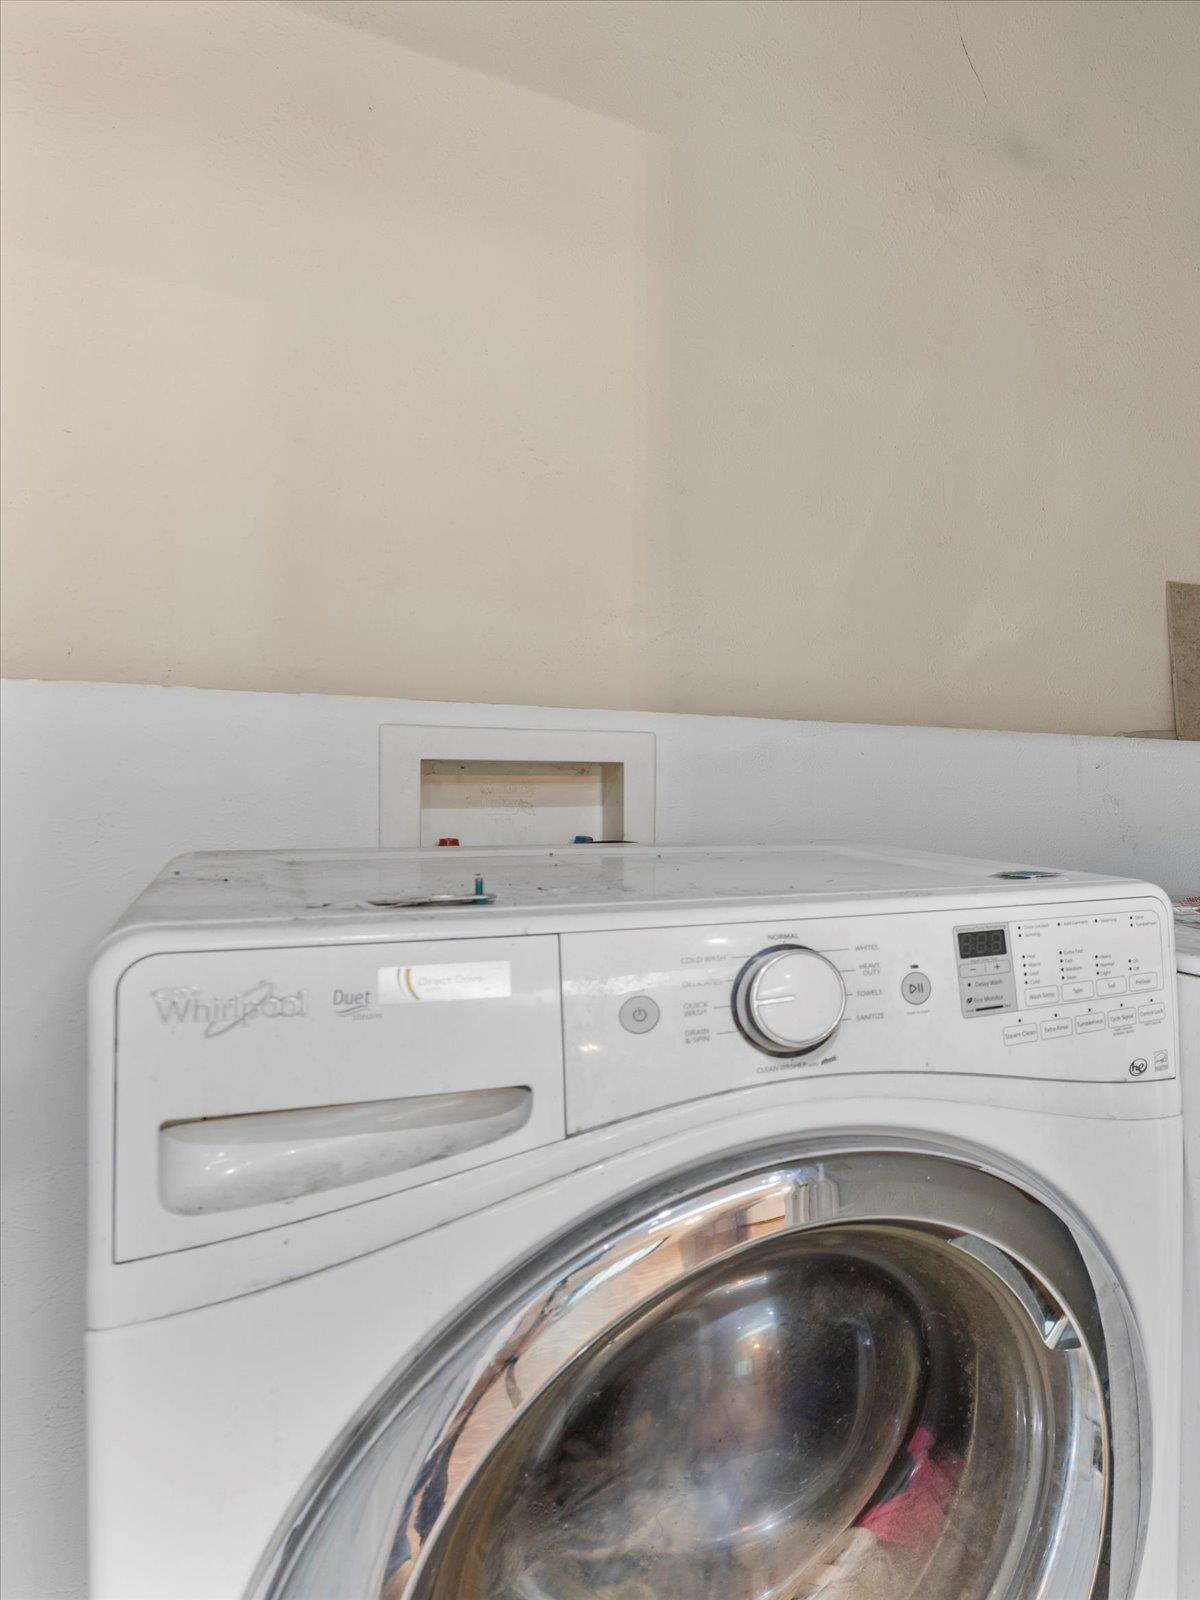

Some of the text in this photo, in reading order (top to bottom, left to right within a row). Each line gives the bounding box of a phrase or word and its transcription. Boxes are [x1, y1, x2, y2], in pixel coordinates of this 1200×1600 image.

[767, 932, 799, 941] NORMAL
[855, 944, 880, 952] WHITES
[333, 988, 372, 1006] Duet
[856, 988, 882, 997] TOWELS
[152, 987, 307, 1029] Whirlpool
[856, 1012, 884, 1021] SANITIZE
